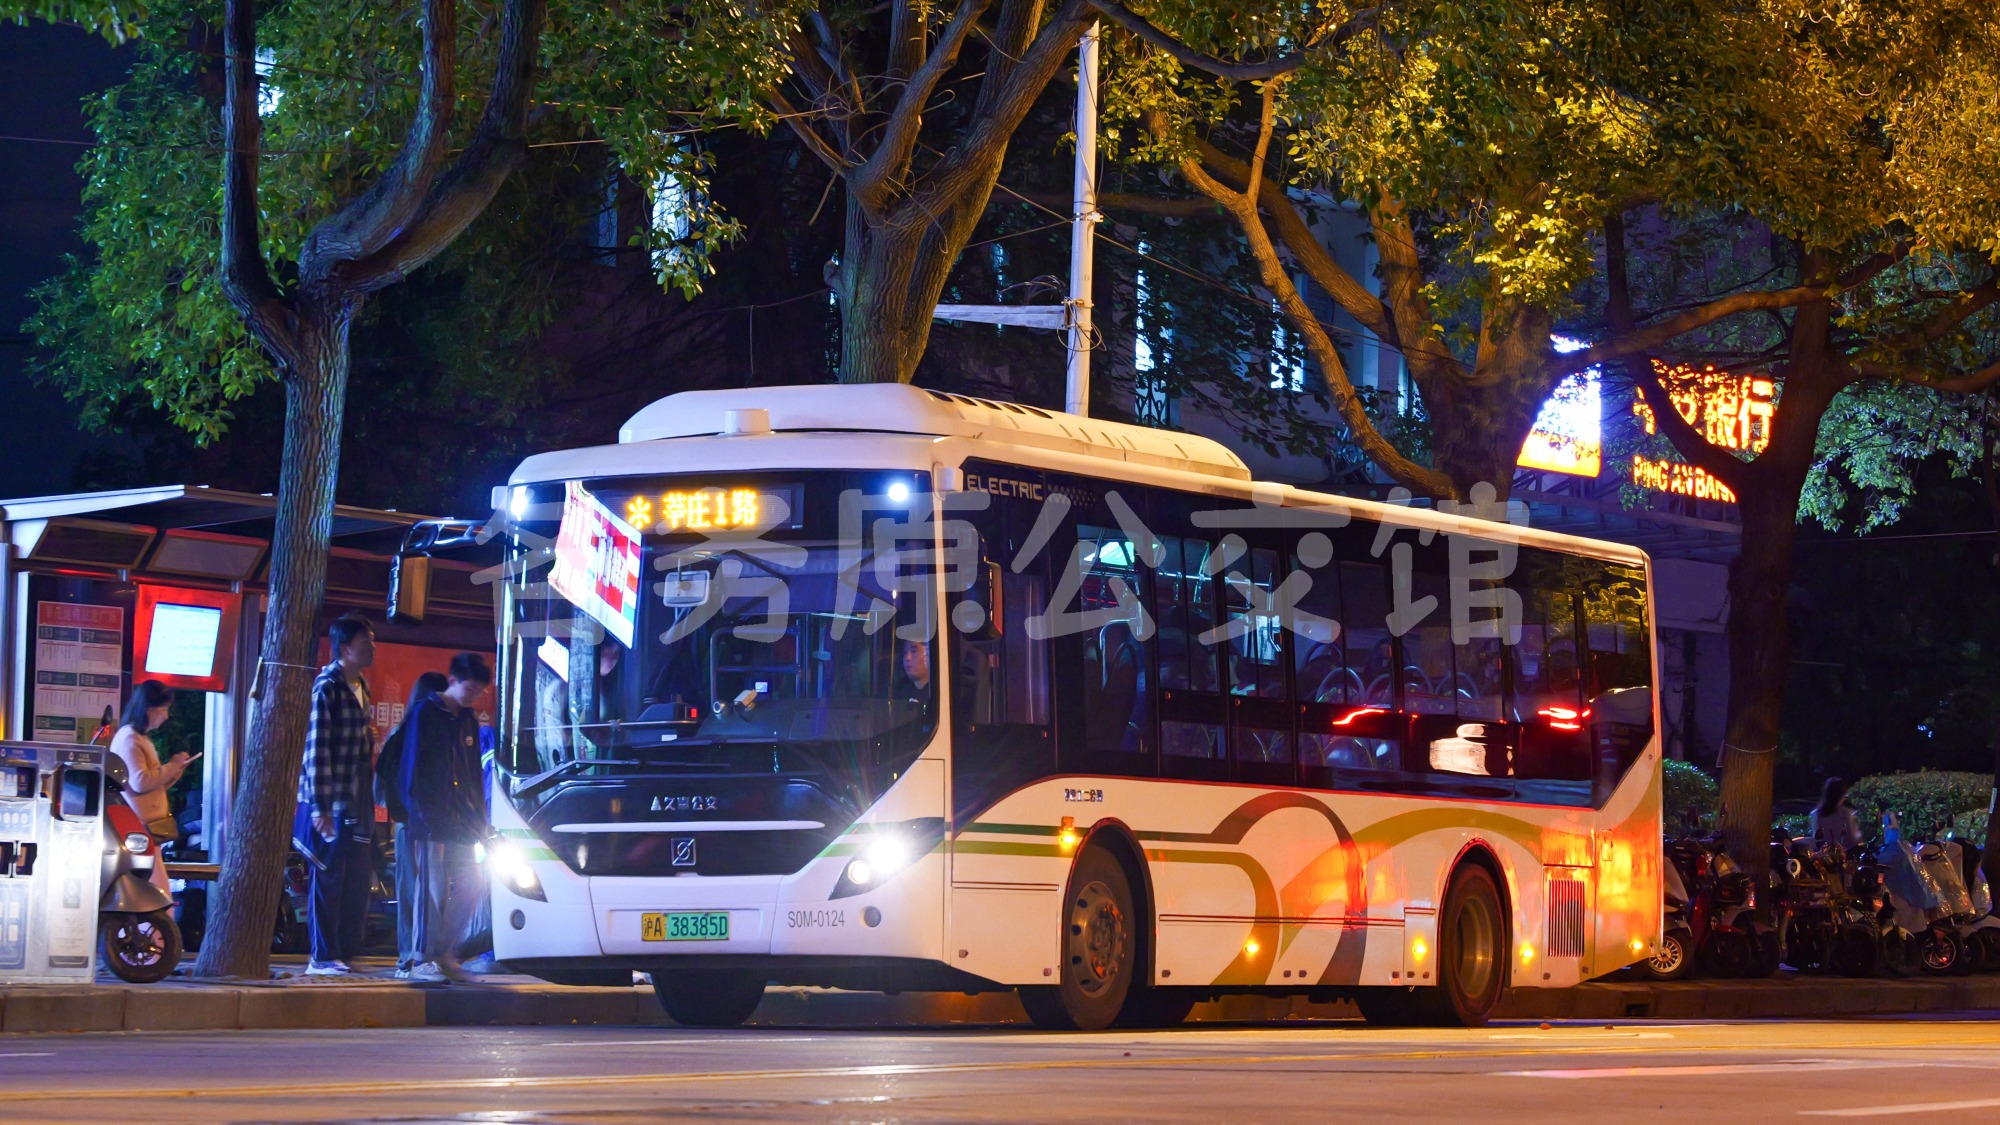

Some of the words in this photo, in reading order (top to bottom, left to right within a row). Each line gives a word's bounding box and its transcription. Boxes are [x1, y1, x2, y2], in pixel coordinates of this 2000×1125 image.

[967, 474, 1043, 501] ELECTRIC
[1634, 456, 1669, 492] PING
[663, 488, 757, 528] 莘庄1路
